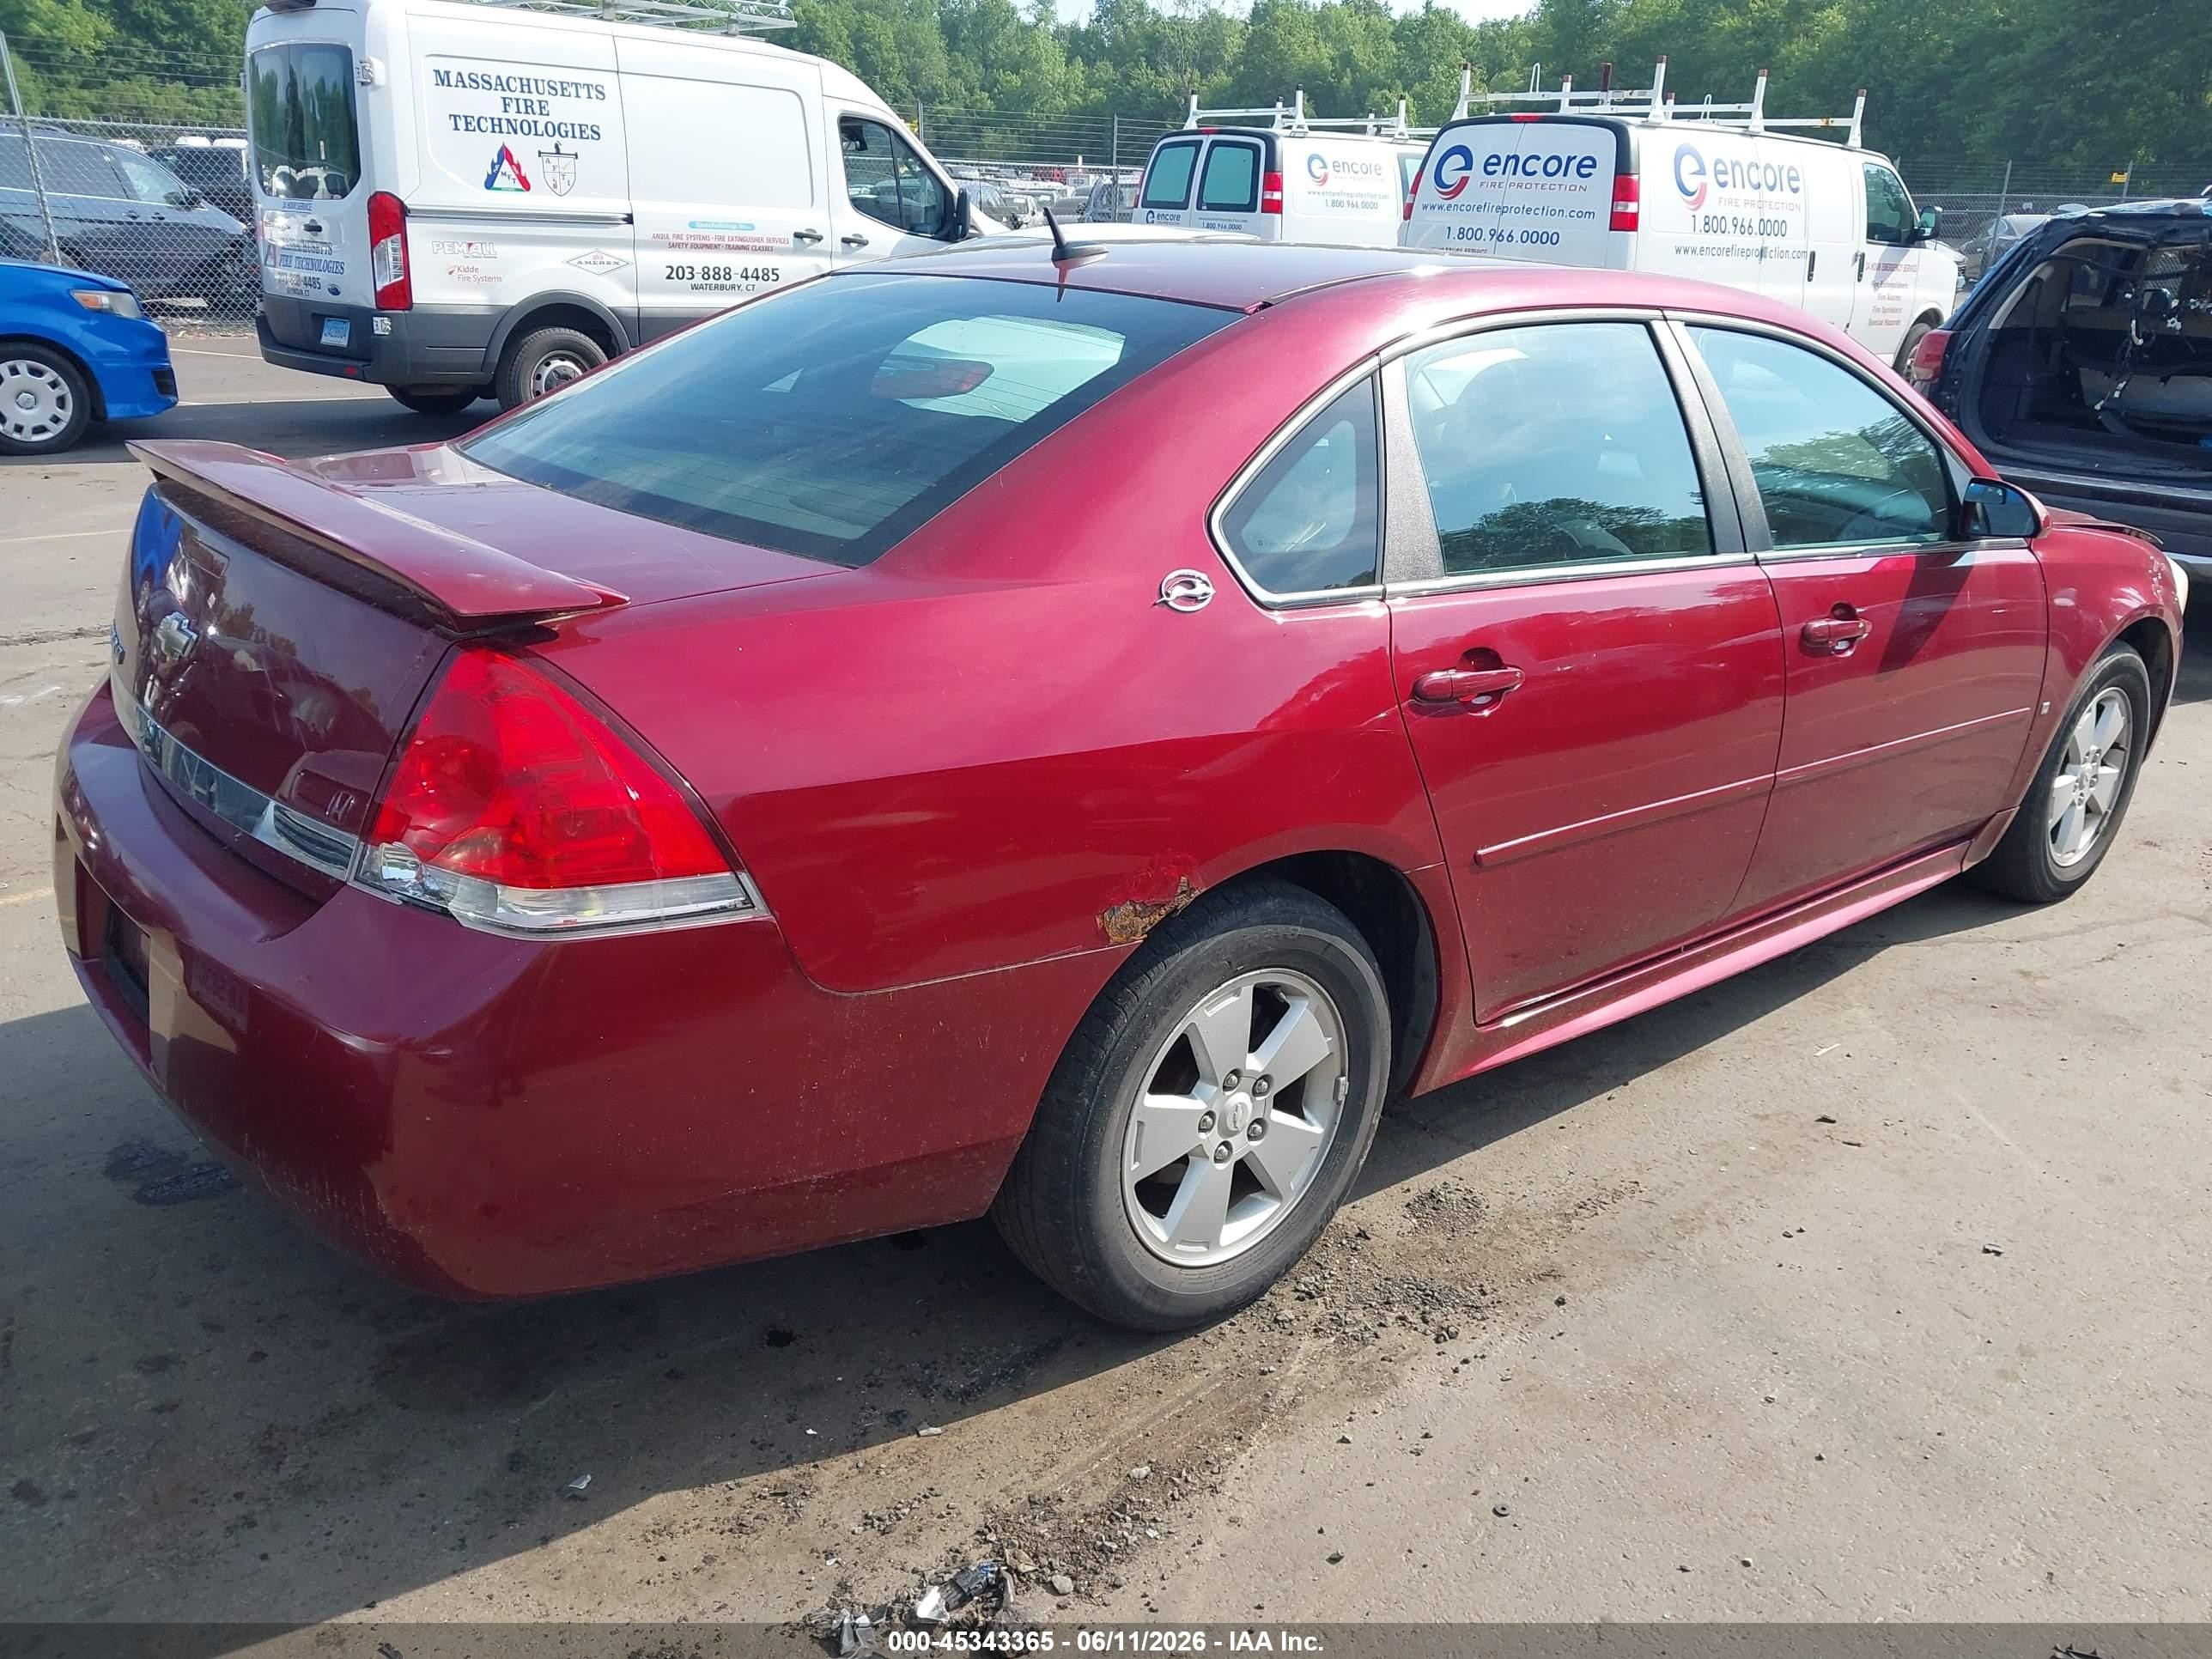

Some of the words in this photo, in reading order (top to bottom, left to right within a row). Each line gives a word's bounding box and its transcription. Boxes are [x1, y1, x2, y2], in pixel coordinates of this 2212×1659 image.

[433, 69, 605, 100] MASSACHUSETTS
[501, 96, 550, 116] FIRE
[449, 113, 600, 141] TECHNOLOGIES
[1332, 161, 1382, 176] encore
[1483, 153, 1597, 179] encore
[1714, 158, 1801, 193] encore
[1508, 182, 1588, 192] PROTECTION
[1422, 202, 1595, 220] www.encorefireprotection.com
[1718, 198, 1740, 207] FIRE
[1744, 199, 1801, 211] PROTECTION
[1157, 213, 1181, 222] encore
[1692, 215, 1787, 237] 1.800.966.0000
[728, 235, 763, 244] EXTINGUISHER
[1445, 227, 1560, 246] 1.800.966.0000
[1675, 245, 1808, 260] www.encorefireproction.com
[279, 254, 293, 267] FIRE
[294, 256, 345, 275] TECHNOLOGIES
[457, 264, 479, 273] Kidde
[473, 274, 502, 284] Systems
[665, 265, 780, 282] 203-888-4485
[690, 283, 743, 292] WATERBURY,
